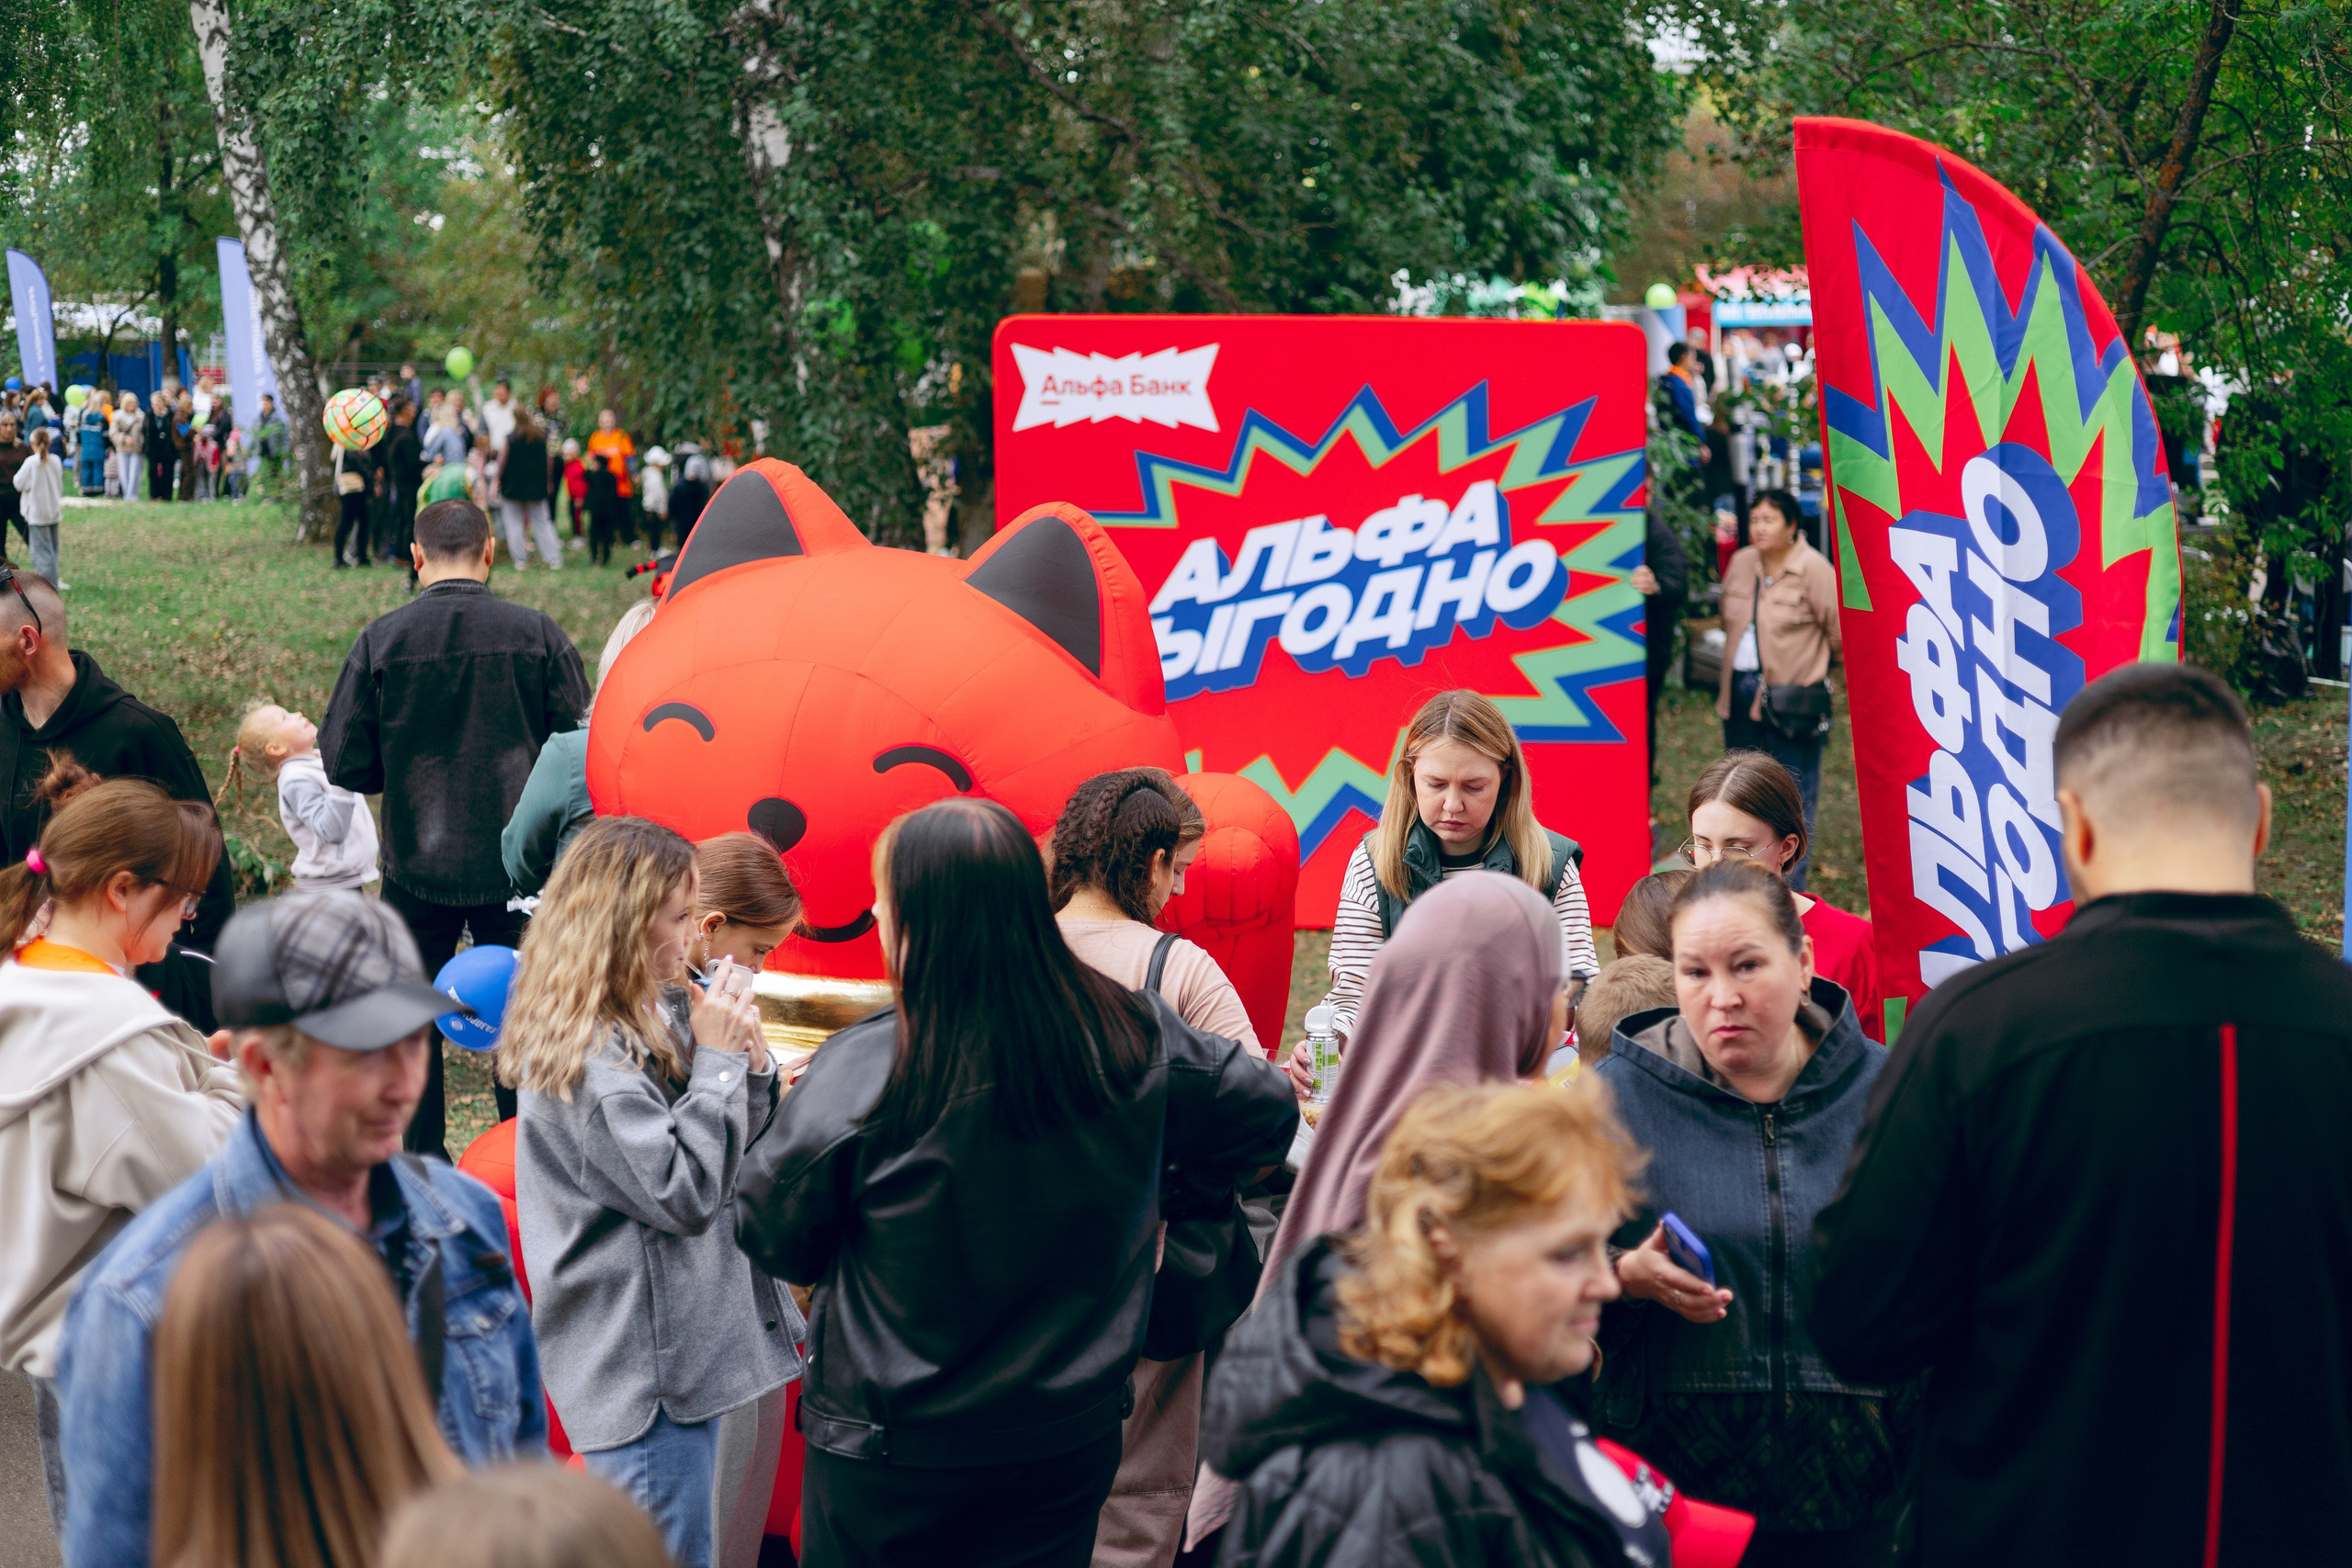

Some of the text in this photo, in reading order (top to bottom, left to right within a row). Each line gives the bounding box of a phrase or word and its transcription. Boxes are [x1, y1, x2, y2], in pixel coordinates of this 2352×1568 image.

[1041, 374, 1192, 401] Альфа Банк
[1148, 479, 1502, 615] АЛЬФА
[1150, 538, 1559, 682] ЫГОДНО
[1962, 457, 2064, 955] ГОДНО
